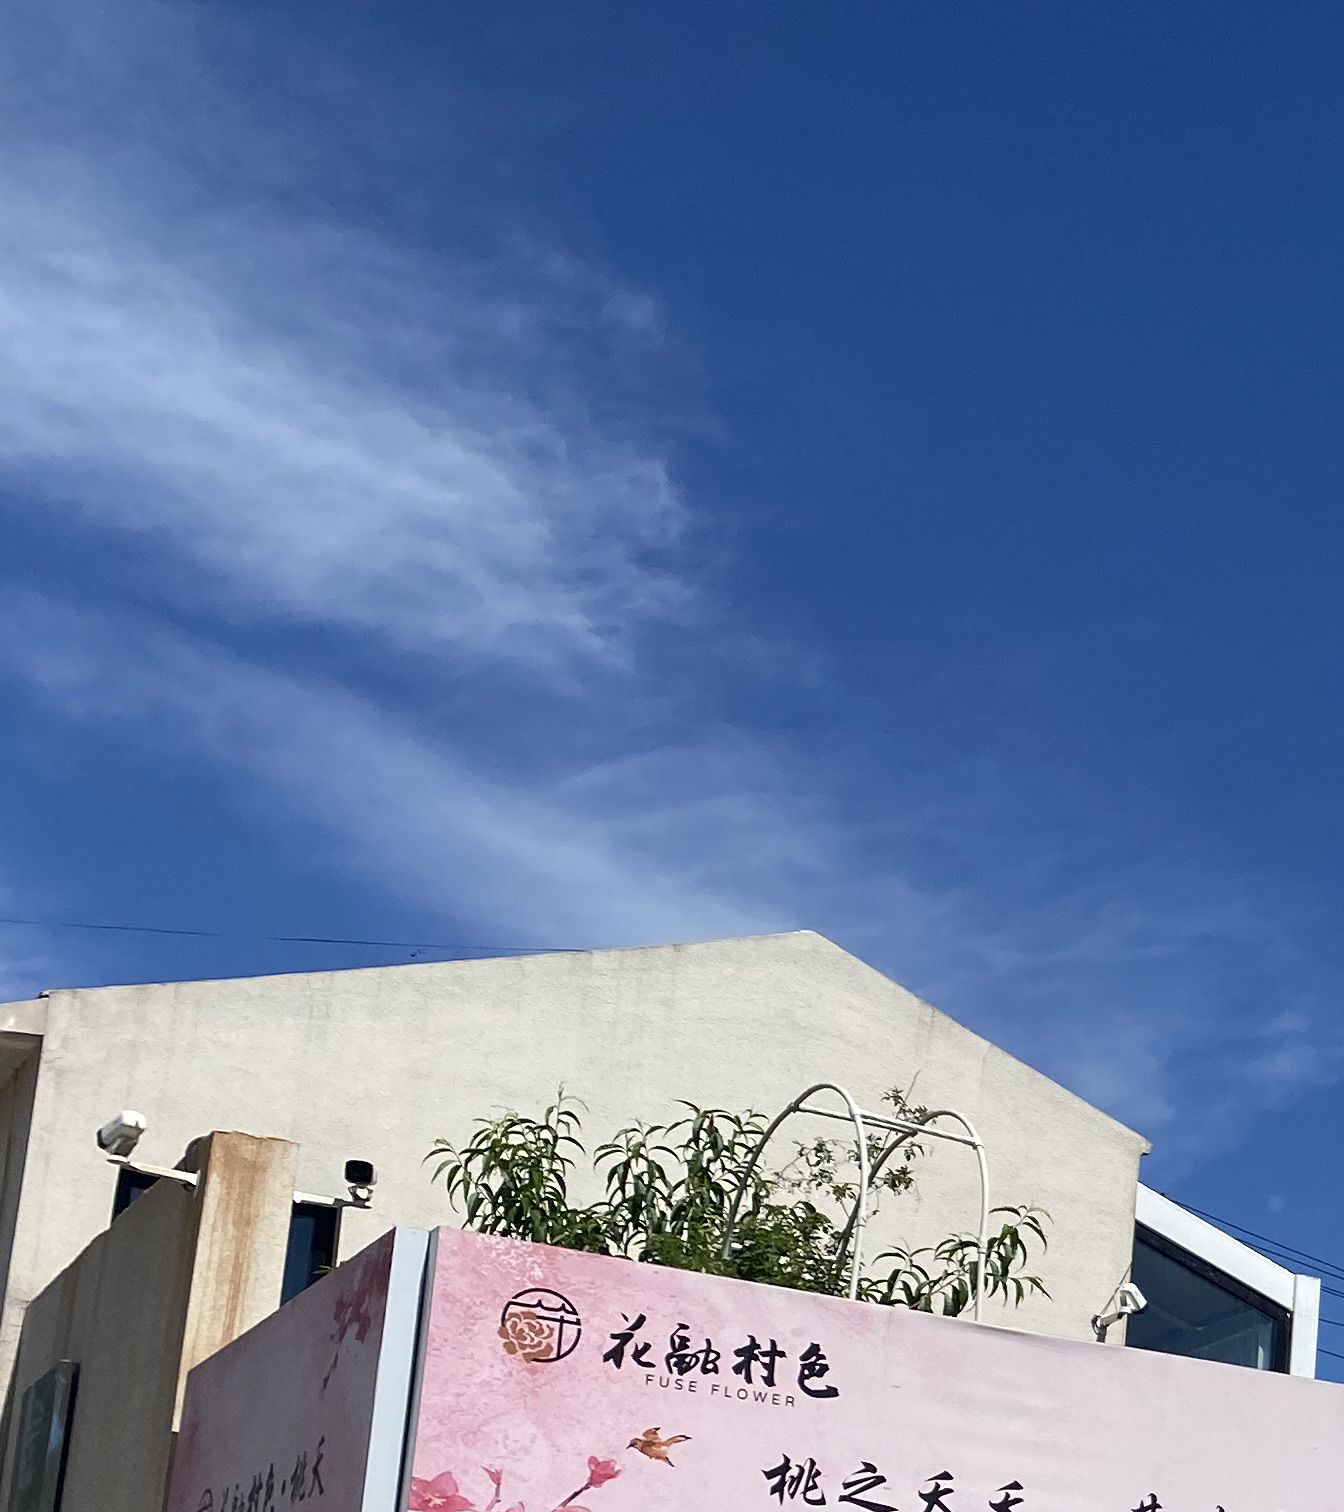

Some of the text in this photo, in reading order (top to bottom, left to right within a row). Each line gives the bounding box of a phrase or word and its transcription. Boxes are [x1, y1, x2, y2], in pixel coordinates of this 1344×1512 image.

[603, 1312, 840, 1399] 花融村色
[645, 1374, 796, 1408] FUSE FLOWER
